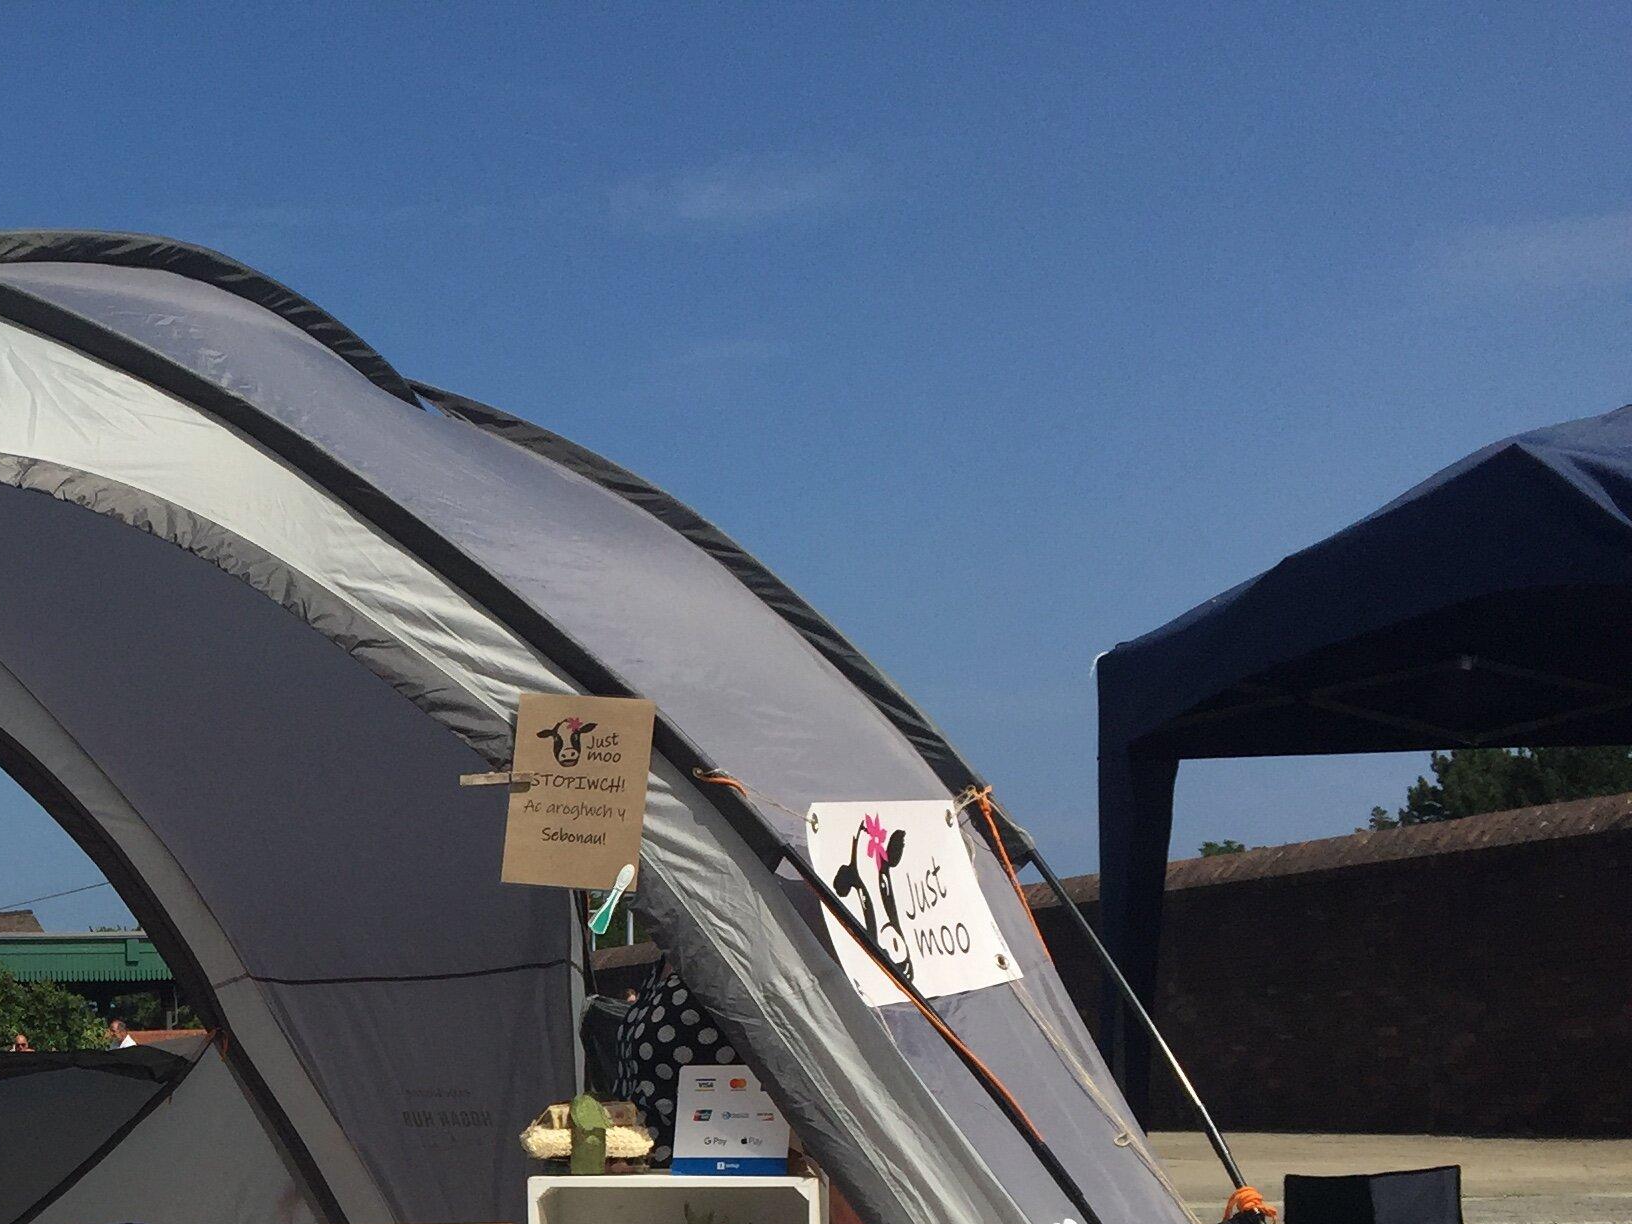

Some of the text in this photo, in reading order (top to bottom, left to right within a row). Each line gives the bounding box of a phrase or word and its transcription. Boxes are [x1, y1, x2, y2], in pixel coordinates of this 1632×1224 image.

[586, 732, 620, 750] Just
[587, 751, 622, 763] moo
[530, 772, 626, 793] STOPIWCH!
[524, 800, 542, 813] Ac
[617, 808, 626, 821] y
[541, 827, 607, 846] Sebonau!
[905, 855, 948, 921] Just
[913, 922, 971, 959] moo
